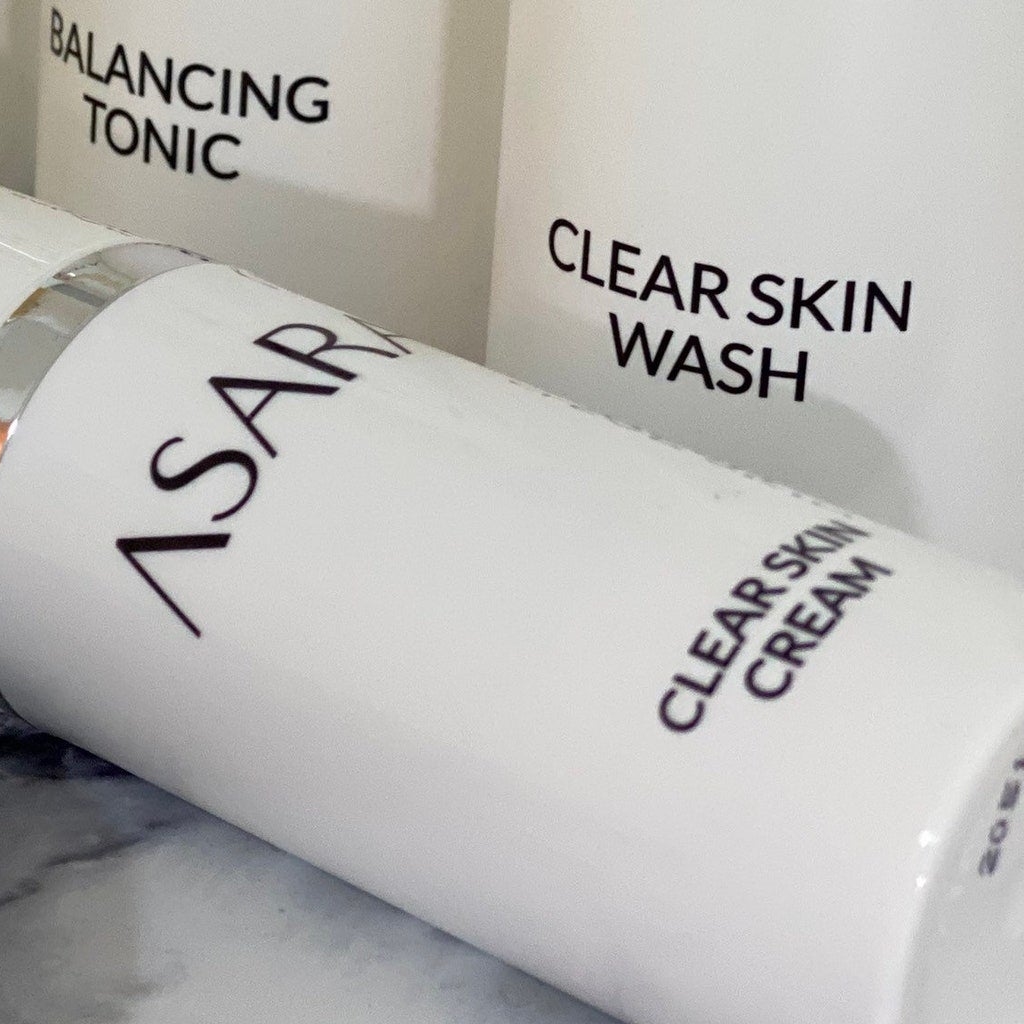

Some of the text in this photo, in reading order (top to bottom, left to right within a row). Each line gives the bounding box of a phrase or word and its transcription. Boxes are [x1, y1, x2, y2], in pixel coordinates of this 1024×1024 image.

[49, 7, 329, 123] BALANCING
[83, 93, 241, 180] TONIC
[548, 218, 911, 332] CLEAR SKIN
[609, 312, 808, 402] WASH
[658, 519, 871, 733] CLEAR SKIN
[743, 556, 893, 700] CREAM
